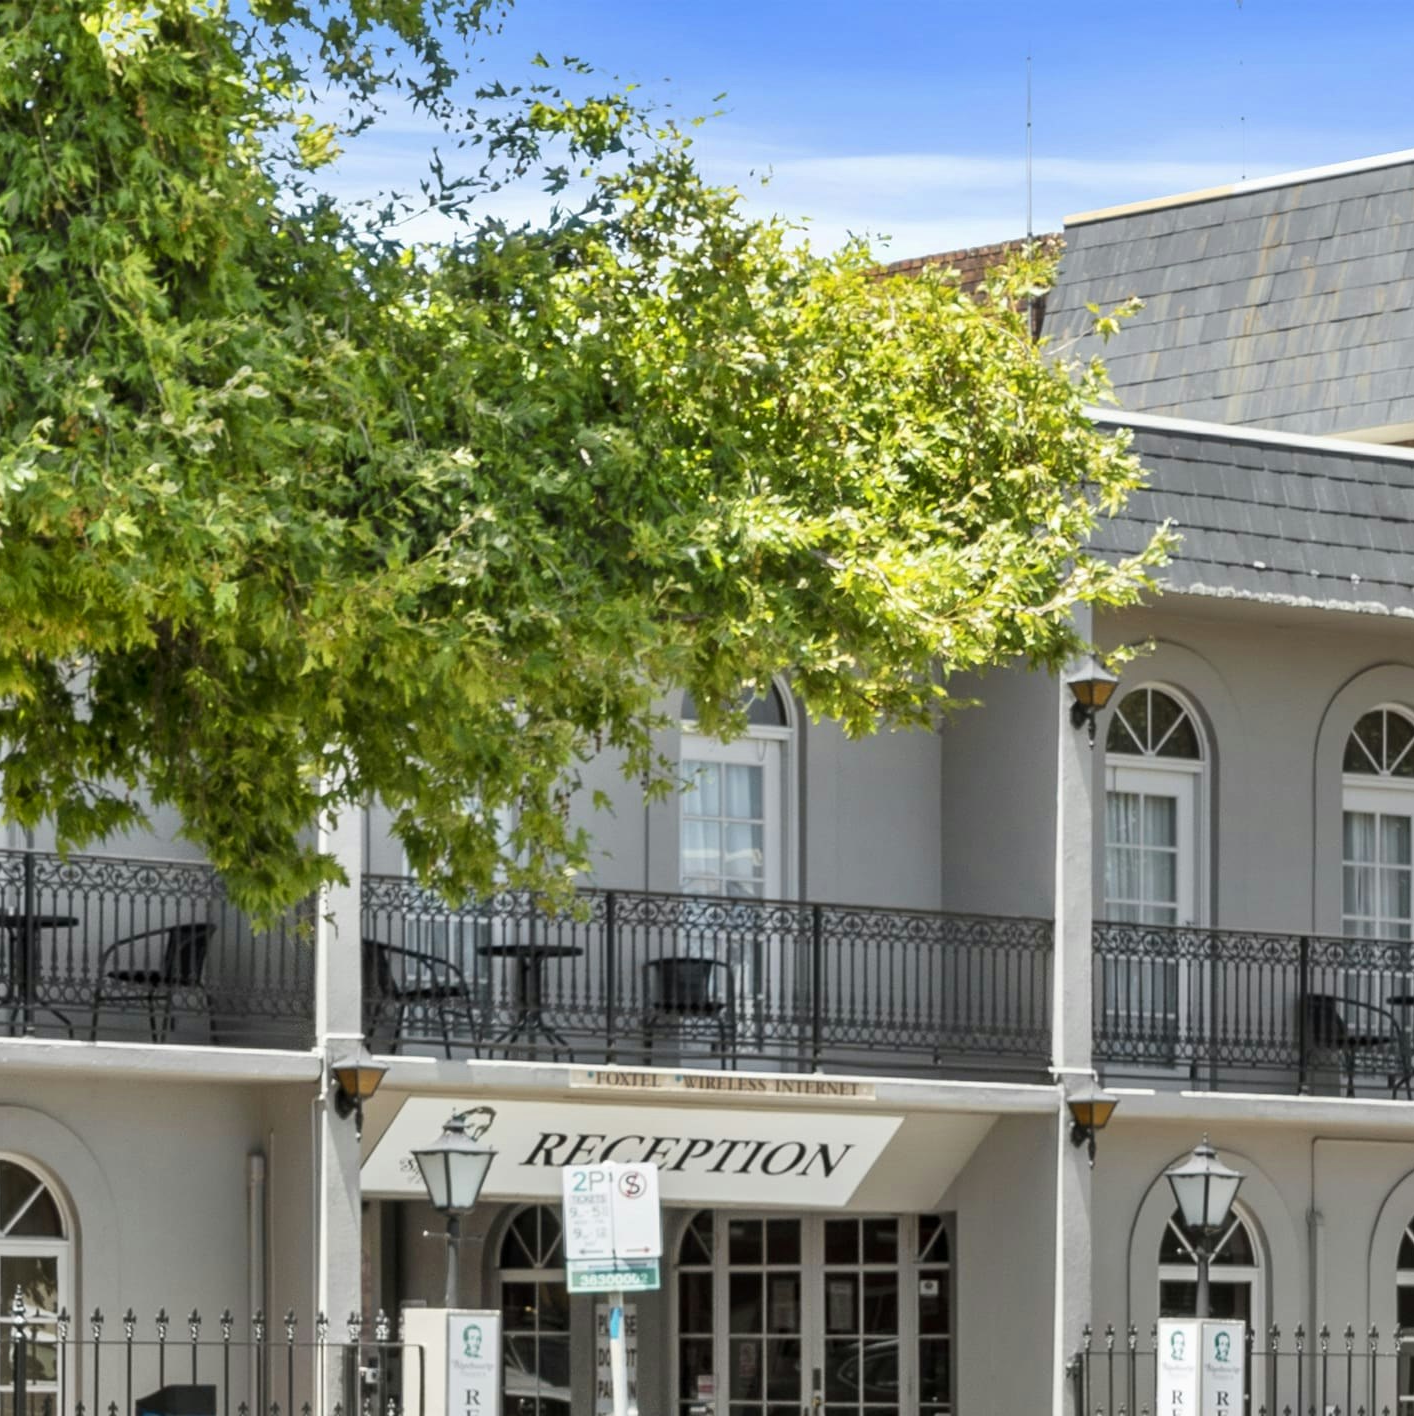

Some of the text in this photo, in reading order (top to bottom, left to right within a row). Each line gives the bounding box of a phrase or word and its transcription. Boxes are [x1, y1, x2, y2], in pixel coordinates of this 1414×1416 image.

[596, 1071, 858, 1096] FOXTEL WIRELESS INTERNET
[518, 1131, 856, 1178] RECEPTION
[572, 1170, 605, 1192] 2P
